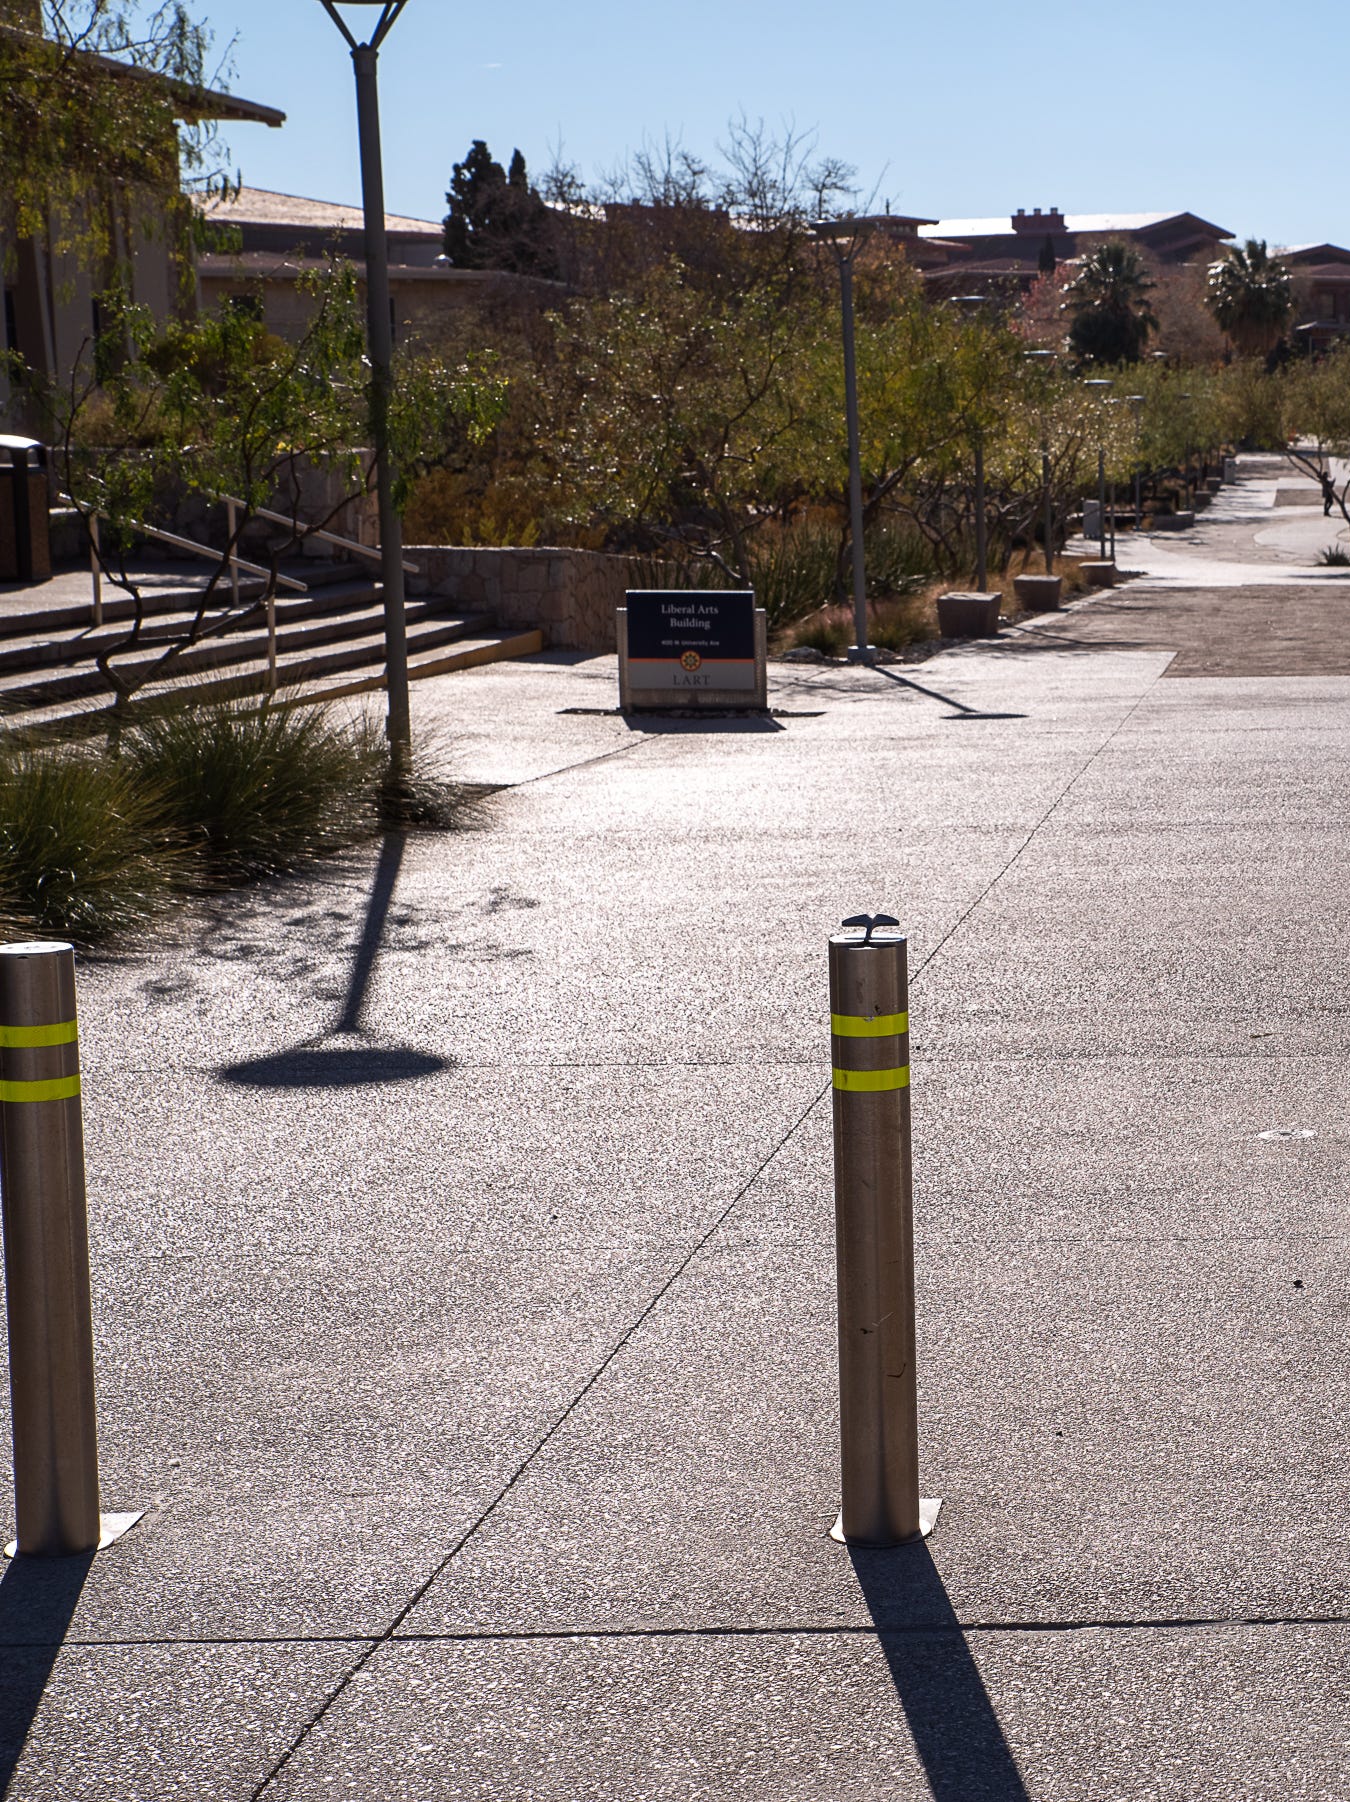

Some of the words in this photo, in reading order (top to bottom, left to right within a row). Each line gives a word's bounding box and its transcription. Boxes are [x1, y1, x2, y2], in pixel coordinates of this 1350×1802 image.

[661, 604, 695, 614] Liberal
[698, 604, 719, 614] Arts
[670, 618, 711, 630] Building
[673, 675, 711, 686] LART
